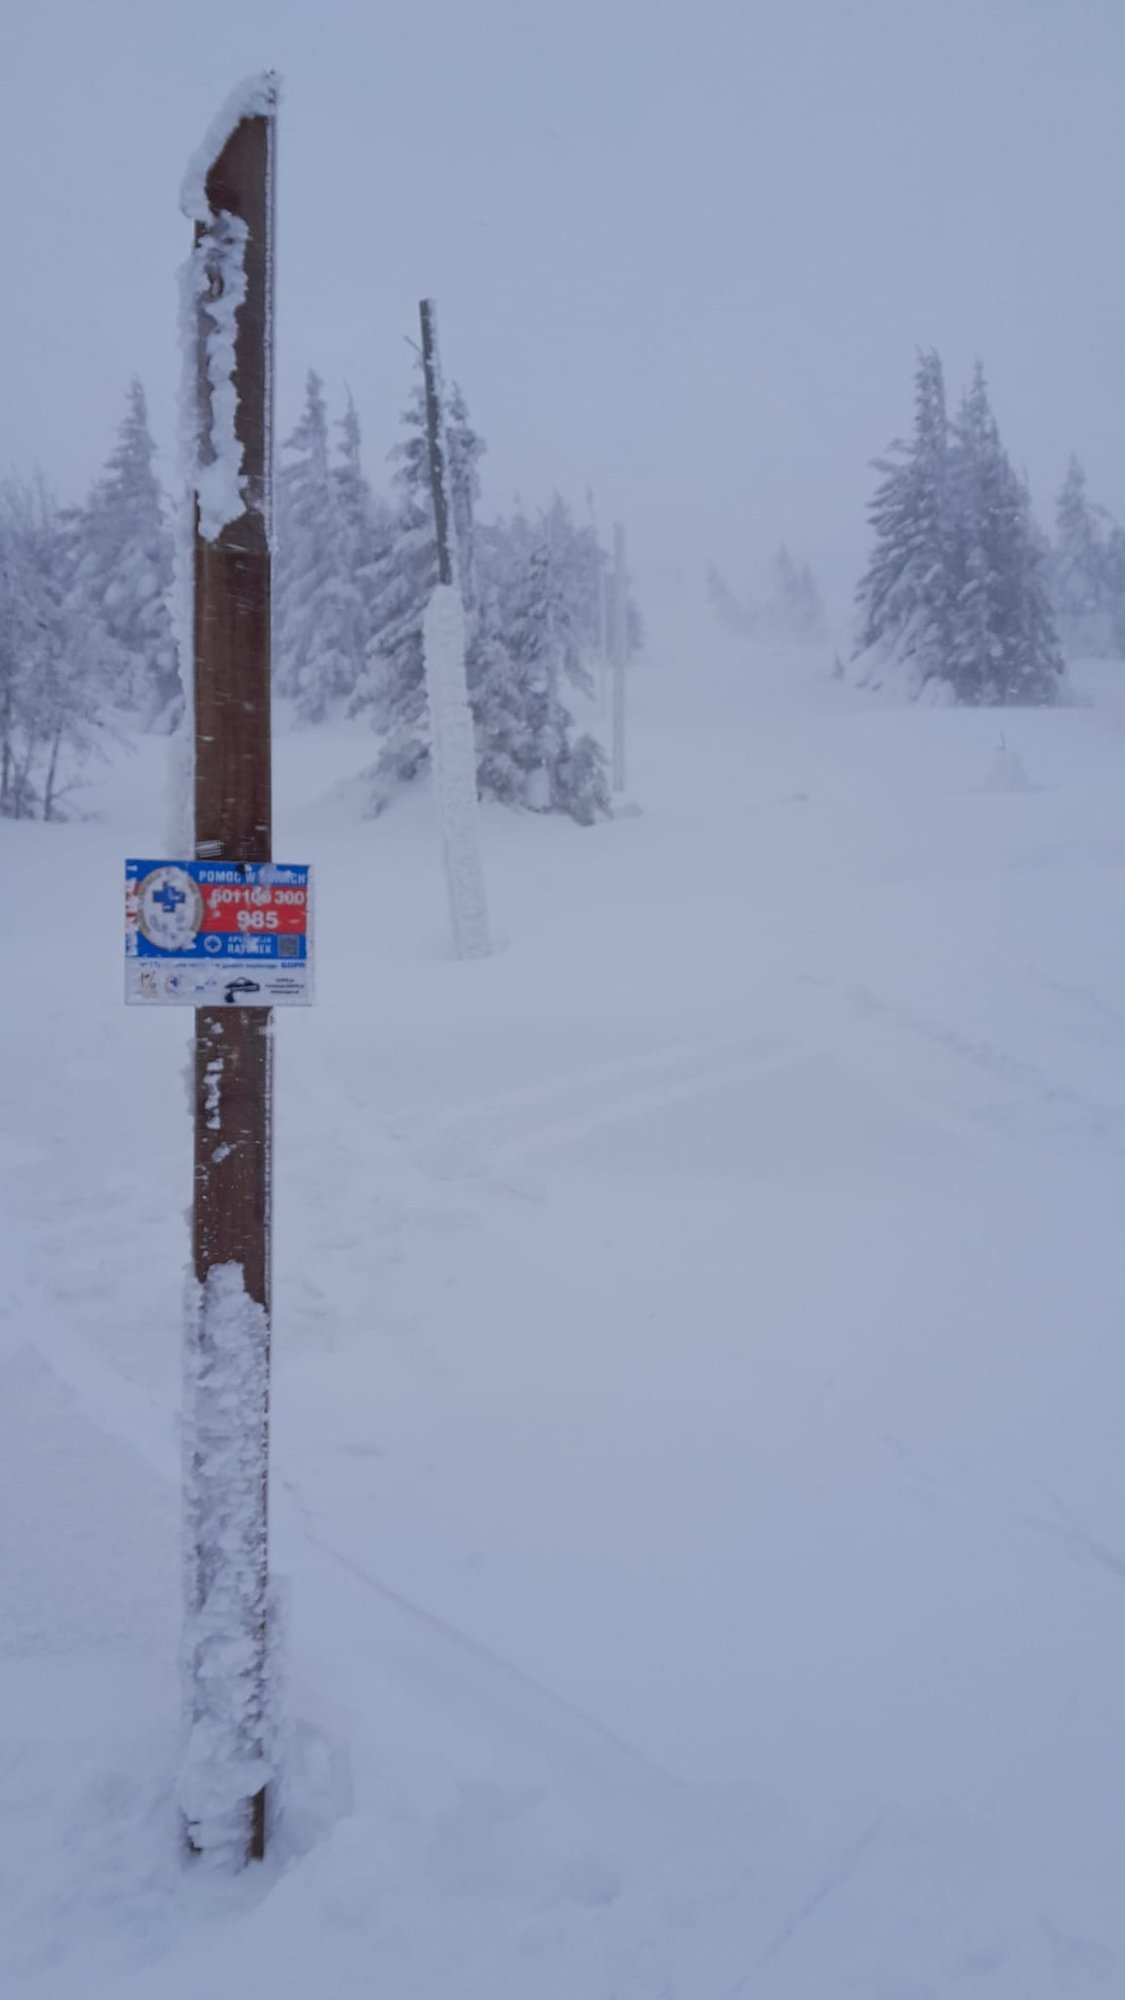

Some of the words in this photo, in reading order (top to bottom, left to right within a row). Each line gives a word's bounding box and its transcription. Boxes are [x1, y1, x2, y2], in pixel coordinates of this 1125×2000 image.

[199, 871, 242, 882] POMOC
[275, 891, 305, 905] 300
[237, 910, 279, 929] 985
